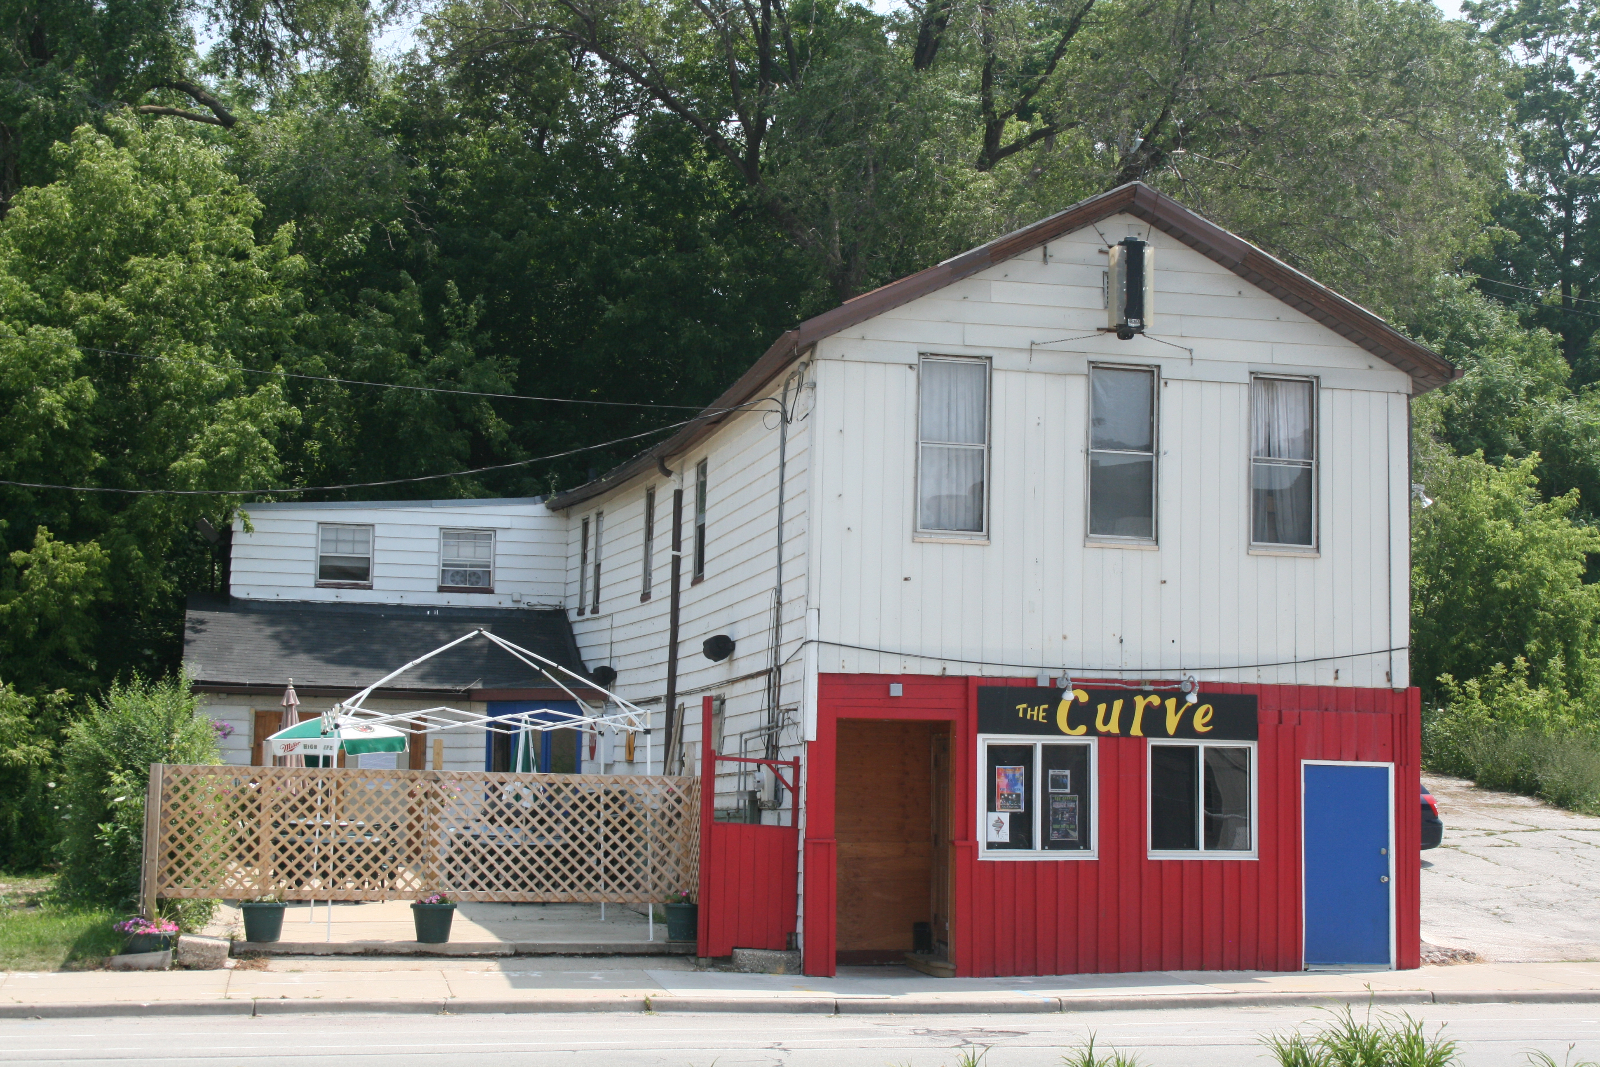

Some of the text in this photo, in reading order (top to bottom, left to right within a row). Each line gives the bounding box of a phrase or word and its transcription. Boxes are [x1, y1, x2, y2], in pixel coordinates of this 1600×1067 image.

[1016, 689, 1214, 736] THE Curve
[280, 742, 301, 753] Miller
